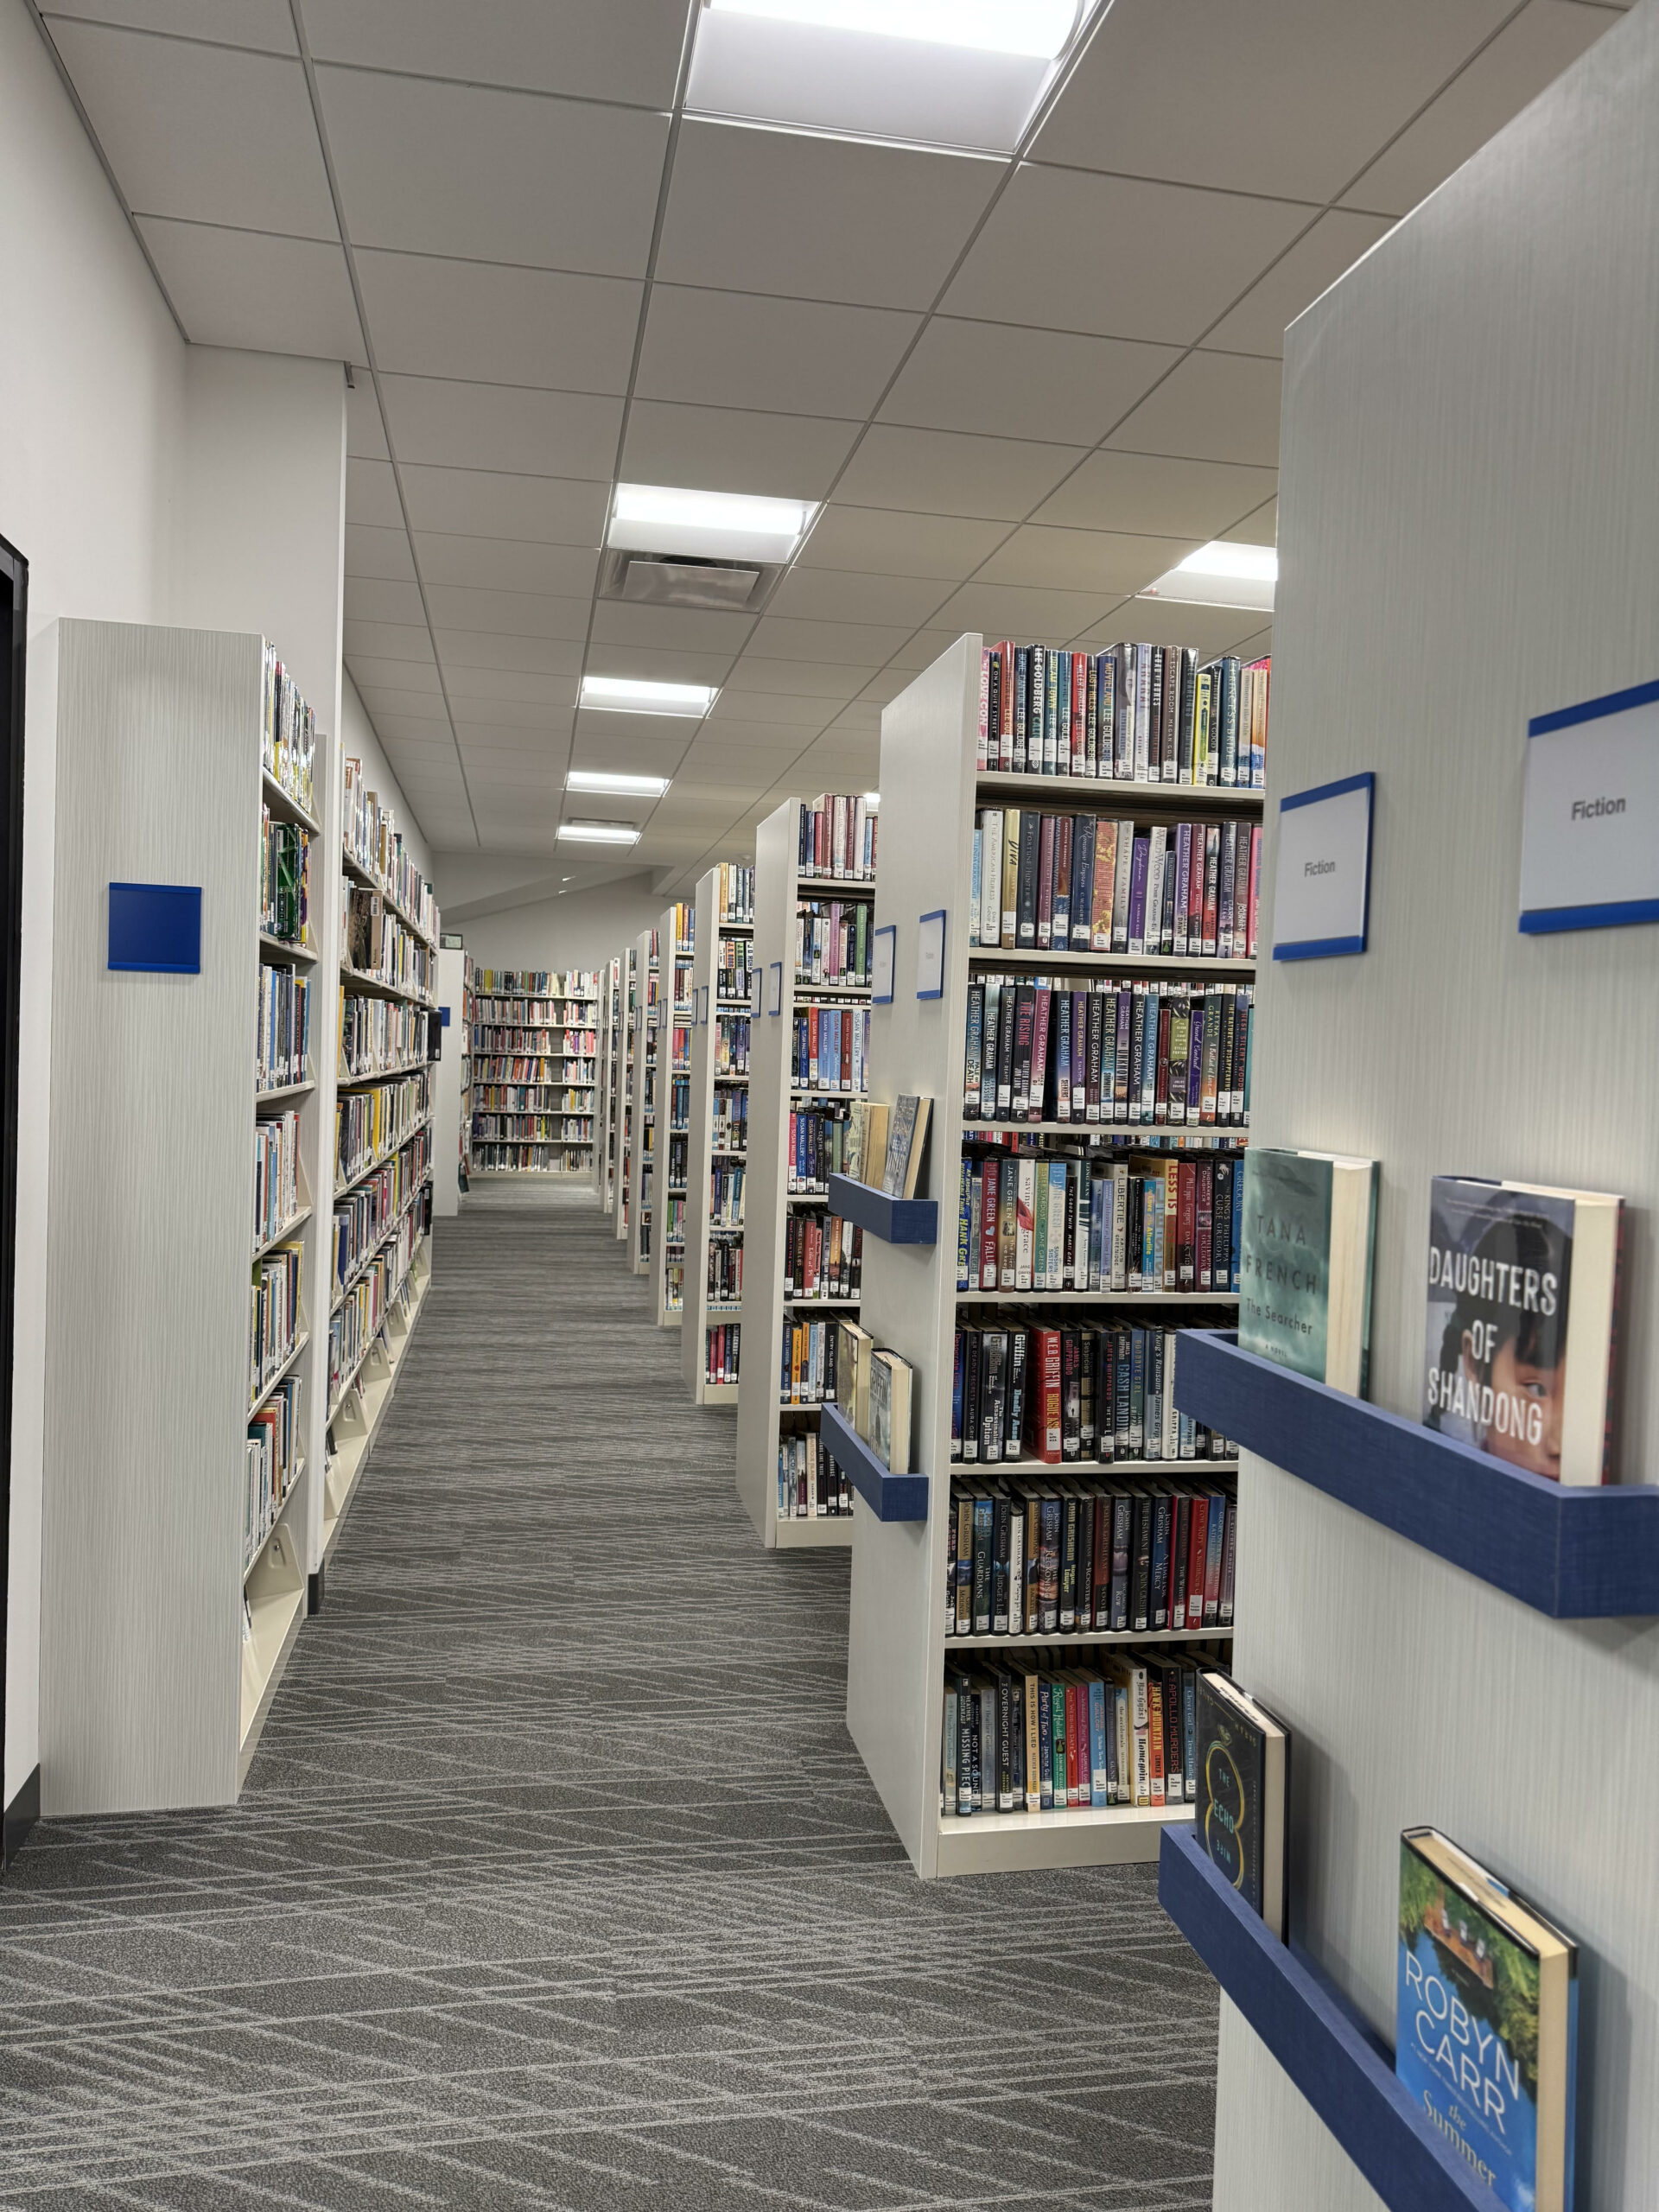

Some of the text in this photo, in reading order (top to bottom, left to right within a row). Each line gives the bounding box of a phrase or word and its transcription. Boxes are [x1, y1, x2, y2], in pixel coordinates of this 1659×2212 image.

[1033, 664, 1043, 714] GOLDBERG
[1048, 687, 1057, 709] TOWN
[1103, 663, 1113, 722] MOVIELAND LEE
[1062, 708, 1071, 718] LEE
[1225, 728, 1236, 760] BRIDE
[1571, 797, 1627, 822] Fiction
[1180, 830, 1191, 908] HEATHER GRAHAM
[1207, 856, 1217, 911] HEATHER GRAHAM
[1223, 834, 1234, 893] HEATHER GRAHAM
[1236, 836, 1249, 895] HEATHER GRAHAM
[1304, 860, 1336, 877] Fiction
[969, 990, 981, 1057] HEATHER GRAHAM
[985, 1013, 996, 1070] HEATHER GRAHAM
[1018, 1001, 1032, 1046] THE RISING
[1037, 995, 1048, 1071] HEATHER GRAHAM
[1059, 1000, 1071, 1066] HEATHER GRAHAM
[1090, 999, 1100, 1083] HEATHER GRAHAM
[1103, 998, 1116, 1069] HEATHER GRAHAM
[1147, 1002, 1158, 1080] HEATHER GRAHAM
[1192, 1020, 1202, 1042] Grand
[1206, 1005, 1215, 1038] GRANDE
[1133, 1002, 1144, 1085] HEATHER GRAHAM
[1238, 1036, 1247, 1062] SILENT
[1116, 1049, 1128, 1087] UNKNOWN
[1224, 1050, 1233, 1091] DISAPPEARING
[1236, 1065, 1245, 1092] WOODS
[986, 1177, 996, 1223] JANE GREEN
[1022, 1177, 1033, 1208] saving
[1116, 1177, 1127, 1224] LIBERTIE
[1167, 1165, 1178, 1210] LESS IS
[1215, 1192, 1224, 1220] CURSE
[1235, 1171, 1243, 1211] GREGORY
[959, 1218, 969, 1244] HANK
[1020, 1228, 1030, 1254] grace
[1145, 1227, 1154, 1255] Afterlife
[1256, 1214, 1306, 1246] TANA
[1246, 1254, 1317, 1295] FRENCH
[1428, 1245, 1558, 1316] DAUGHTERS
[1246, 1297, 1313, 1337] The Searcher
[1065, 1339, 1073, 1376] GRIPPANDO
[1083, 1341, 1091, 1374] Suspicion
[1133, 1339, 1141, 1374] GOODBYE
[1472, 1319, 1498, 1363] OF
[1011, 1334, 1026, 1417] Griffin Deadly
[1045, 1357, 1060, 1416] GRIFFIN ROGUE
[1116, 1363, 1130, 1392] CASH
[1153, 1334, 1163, 1420] King's Ransom James
[1427, 1366, 1542, 1446] SHANDONG
[982, 1417, 994, 1445] Option
[963, 1523, 971, 1556] GRISHAM
[999, 1504, 1009, 1558] JOHN GRISHAM
[1046, 1506, 1055, 1541] GRISHAM
[1066, 1523, 1076, 1561] GRISHAM
[1116, 1504, 1125, 1540] GRISHAM
[1156, 1506, 1165, 1543] GRISHAM
[976, 1551, 986, 1599] GUARDIANS
[1044, 1549, 1054, 1599] RECKONING
[1154, 1562, 1164, 1591] MERCY
[1039, 1691, 1050, 1711] Party
[1052, 1688, 1064, 1711] Royal
[1152, 1687, 1162, 1751] HAWK MOUNTAIN
[961, 1728, 971, 1764] MISSING
[1001, 1688, 1010, 1767] OVERNIGHT GUEST
[1168, 1684, 1179, 1773] APOLLO MURDERS
[970, 1764, 979, 1795] SOUND
[1218, 1768, 1230, 1788] THE
[1213, 1797, 1235, 1834] ECHO
[1405, 1949, 1520, 2101] ROBYN
[1415, 2010, 1506, 2135] CARR
[1422, 2089, 1497, 2187] Summer
[1448, 2105, 1467, 2132] the
